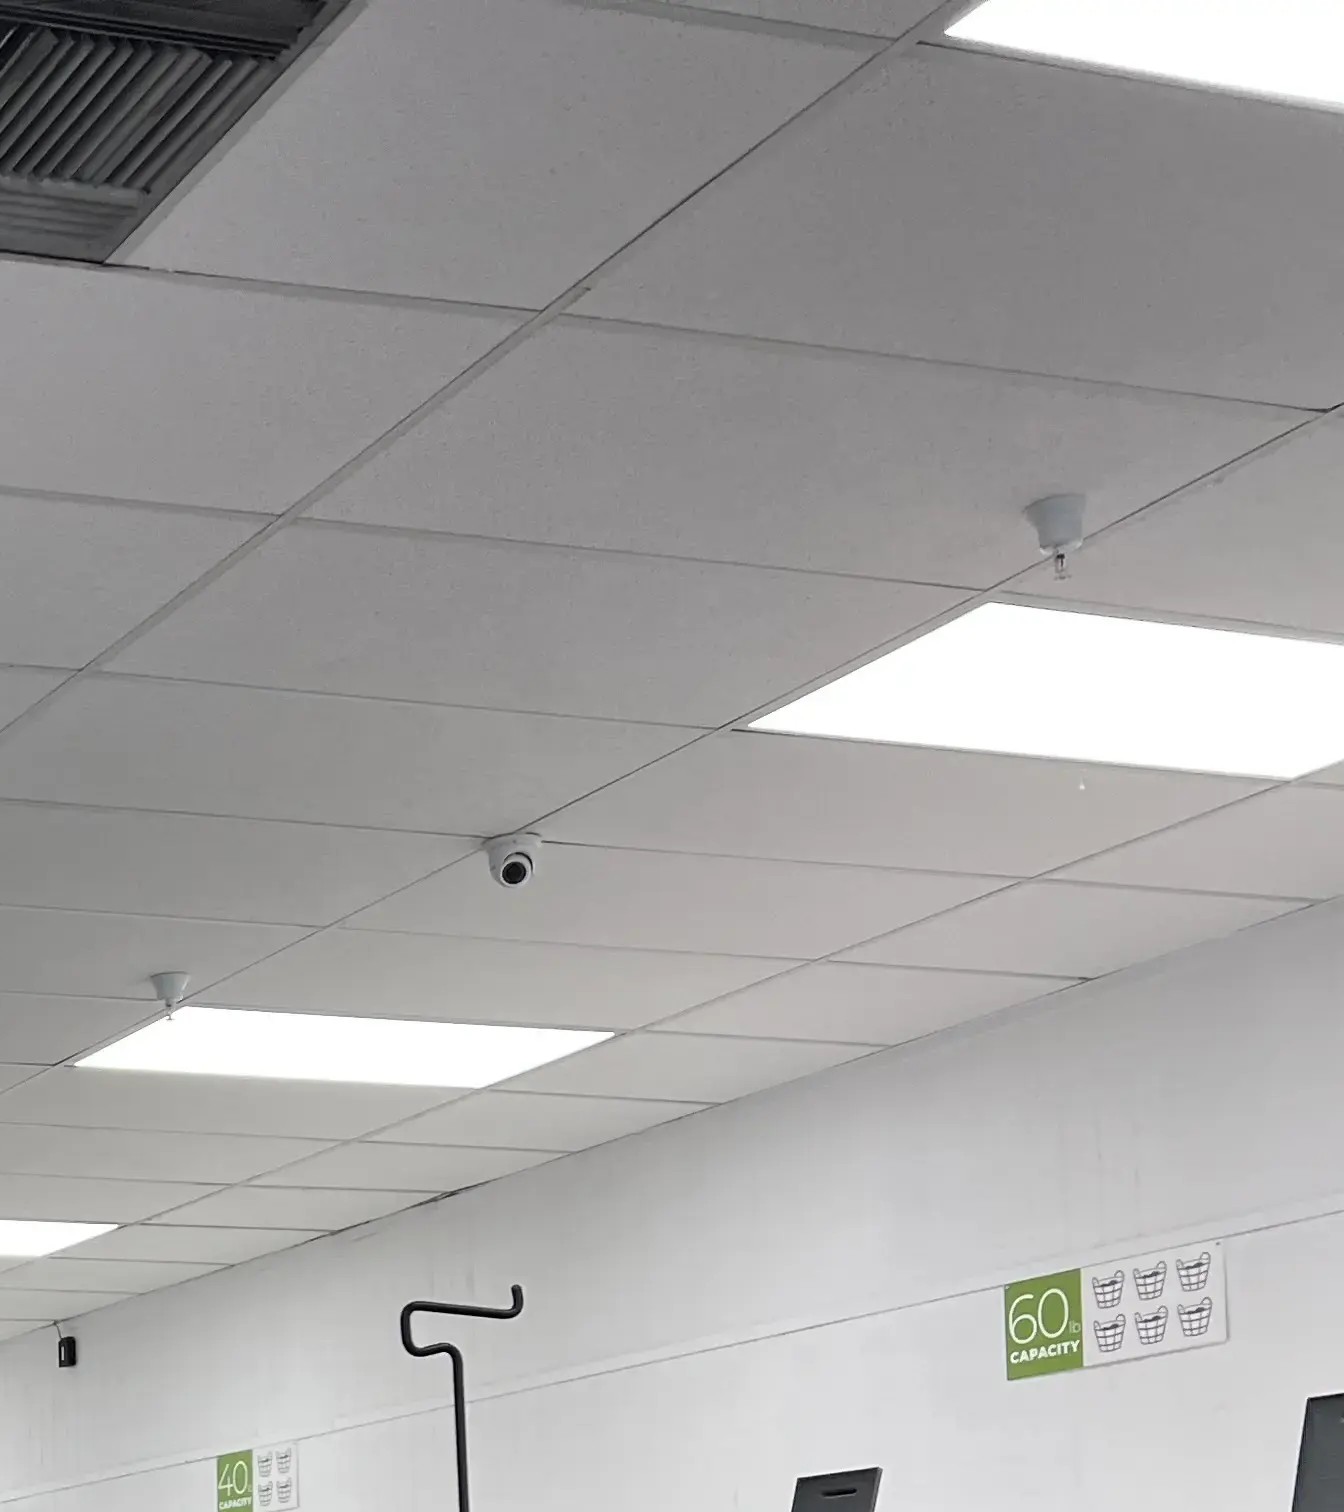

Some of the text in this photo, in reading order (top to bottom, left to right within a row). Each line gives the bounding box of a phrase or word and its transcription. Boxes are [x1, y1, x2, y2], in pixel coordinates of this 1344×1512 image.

[1008, 1288, 1069, 1345] 60
[1009, 1340, 1081, 1364] CAPACITY
[218, 1460, 248, 1496] 40
